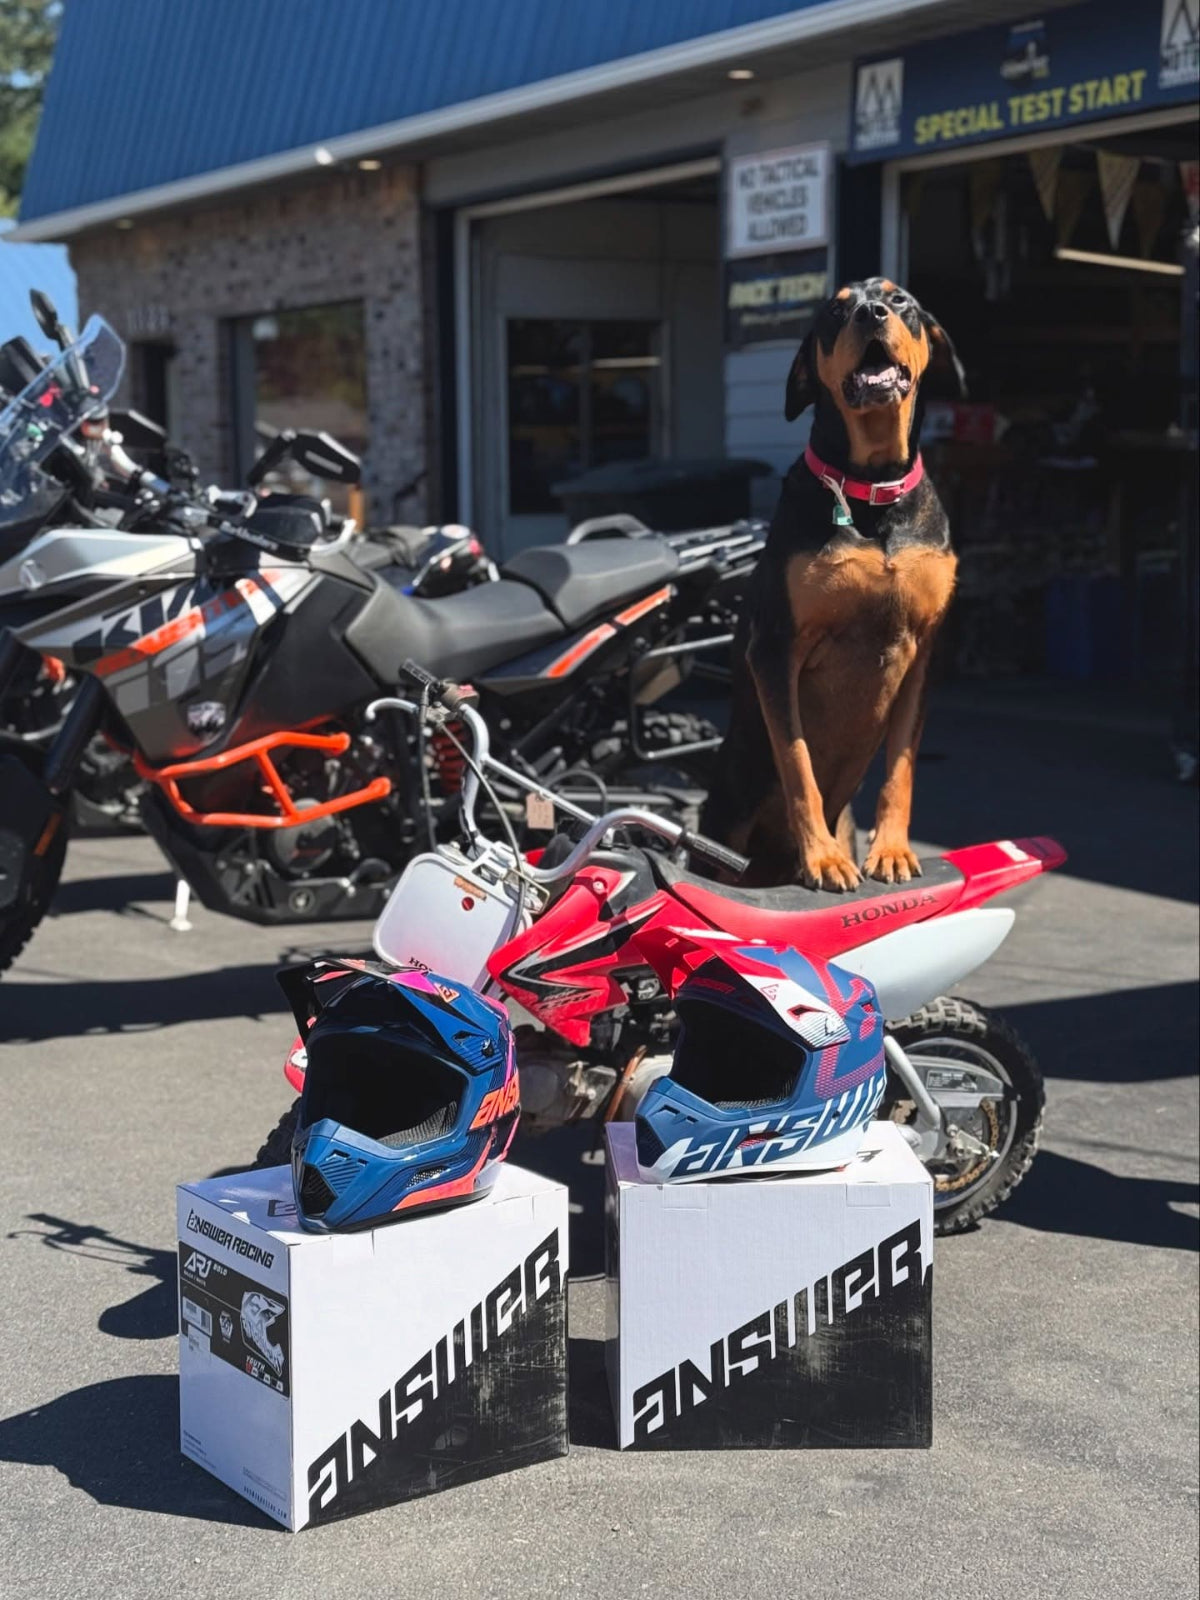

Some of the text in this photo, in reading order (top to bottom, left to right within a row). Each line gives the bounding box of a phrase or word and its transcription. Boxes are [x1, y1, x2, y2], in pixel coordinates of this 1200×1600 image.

[914, 103, 1004, 144] SPECIAL
[1008, 88, 1067, 126] TEST
[1068, 70, 1147, 114] START
[748, 213, 807, 241] ALLOWED
[841, 894, 937, 928] HONDA
[408, 956, 432, 973] HO
[186, 1208, 275, 1270] ANSWER RACING
[628, 1217, 928, 1446] ANSWER
[246, 1355, 266, 1374] YOUTH
[300, 1227, 566, 1520] ANSWER
